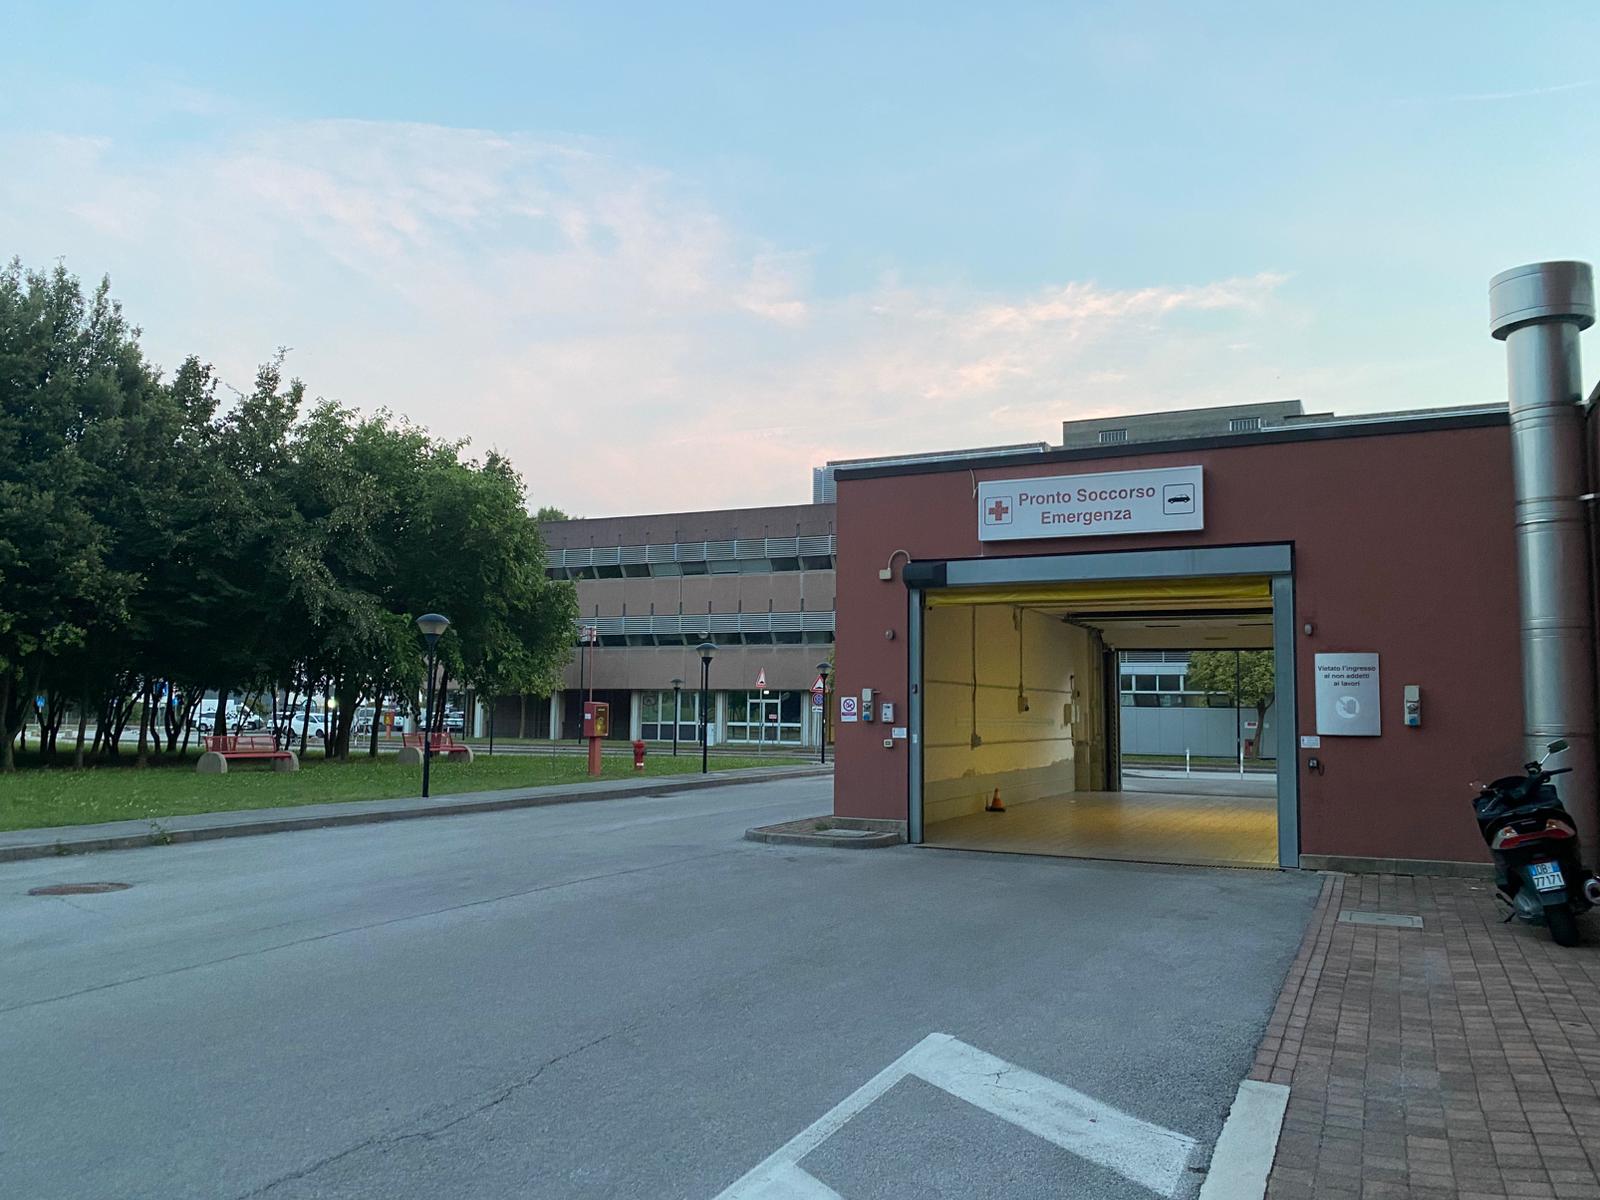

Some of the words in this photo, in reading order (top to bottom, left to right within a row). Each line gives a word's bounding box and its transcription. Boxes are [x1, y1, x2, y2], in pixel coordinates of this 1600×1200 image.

[1018, 491, 1072, 507] Pronto
[1076, 486, 1156, 503] Soccorso
[1041, 508, 1132, 525] Emergenza
[1342, 665, 1376, 673] l'ingresso
[1534, 873, 1562, 887] 77171
